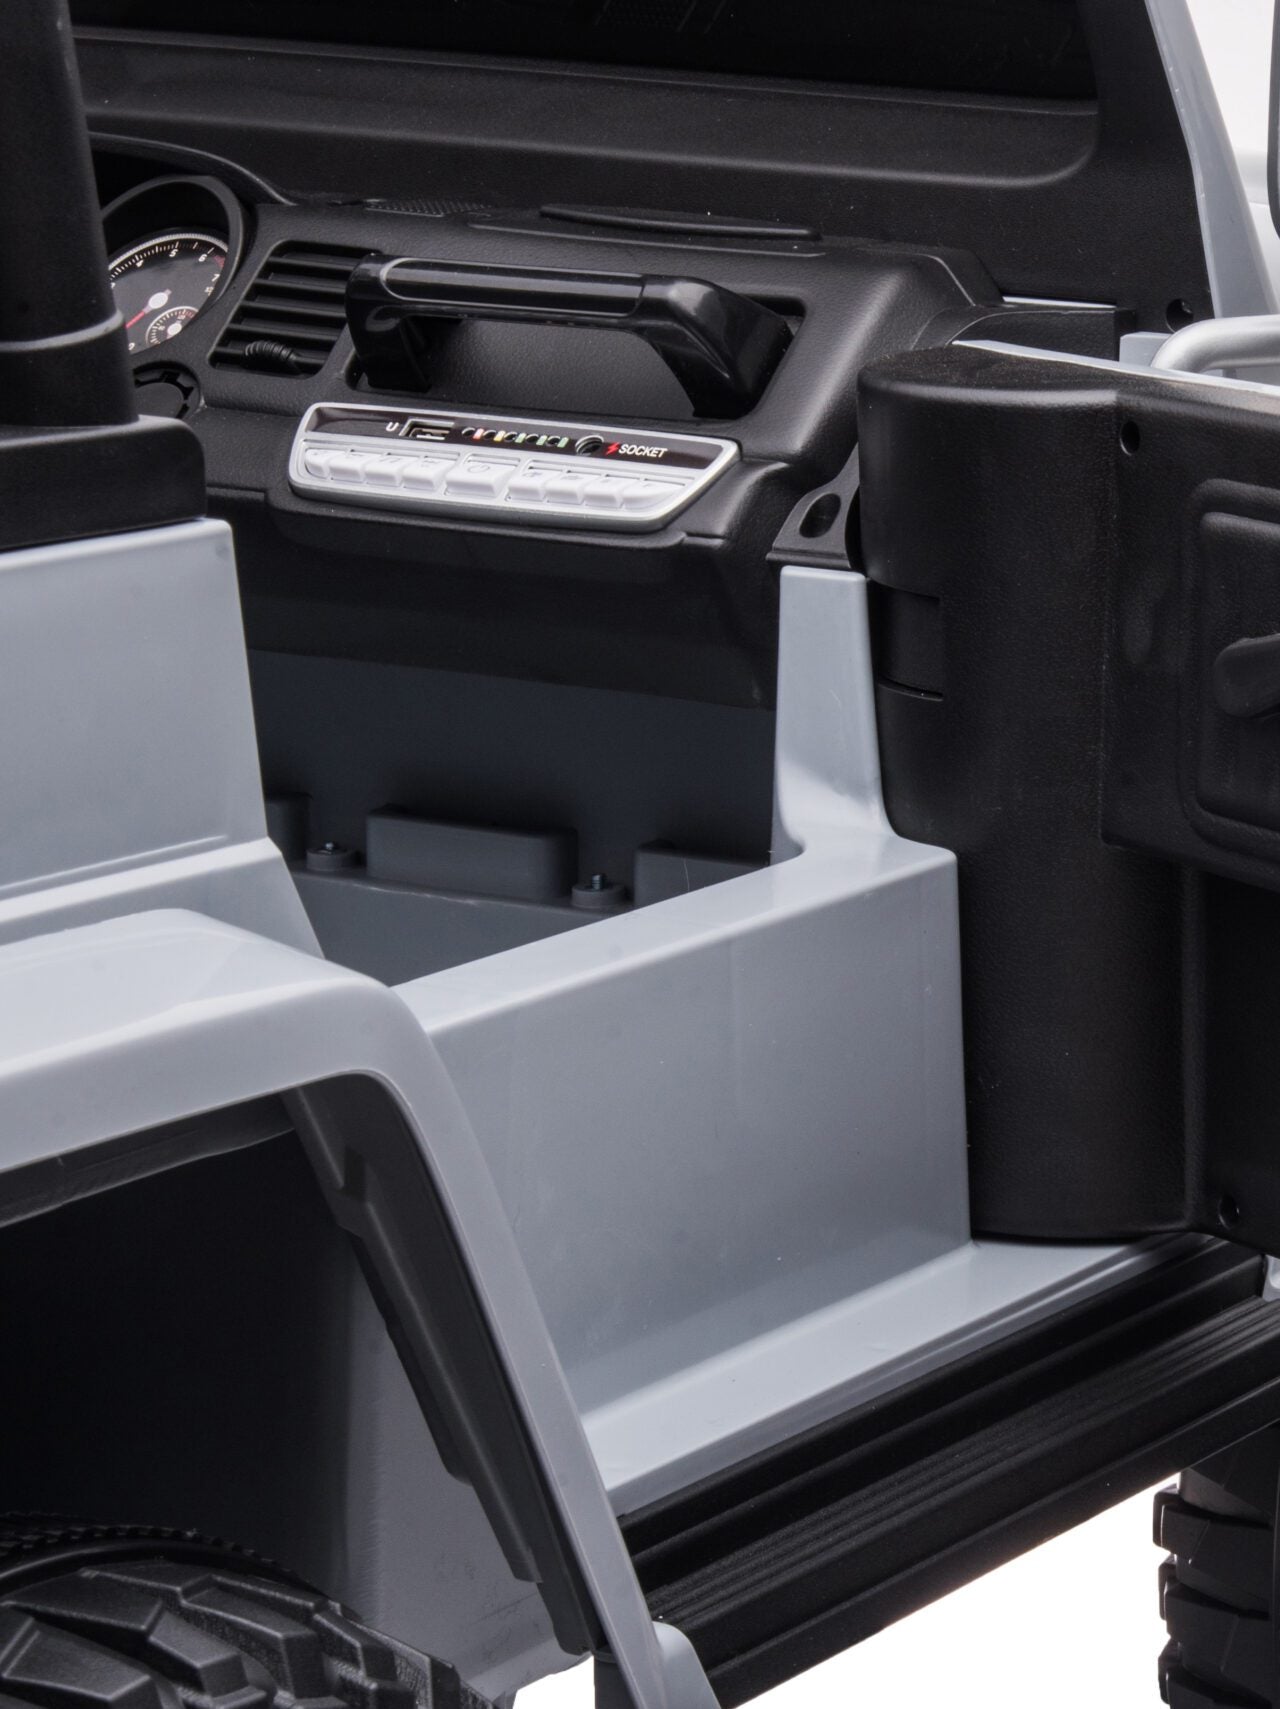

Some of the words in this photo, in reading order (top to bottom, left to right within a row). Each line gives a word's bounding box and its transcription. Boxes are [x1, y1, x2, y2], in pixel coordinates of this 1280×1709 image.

[169, 248, 179, 258] 5
[198, 253, 208, 263] 6
[211, 273, 220, 282] 7
[618, 443, 669, 458] SOCKET
